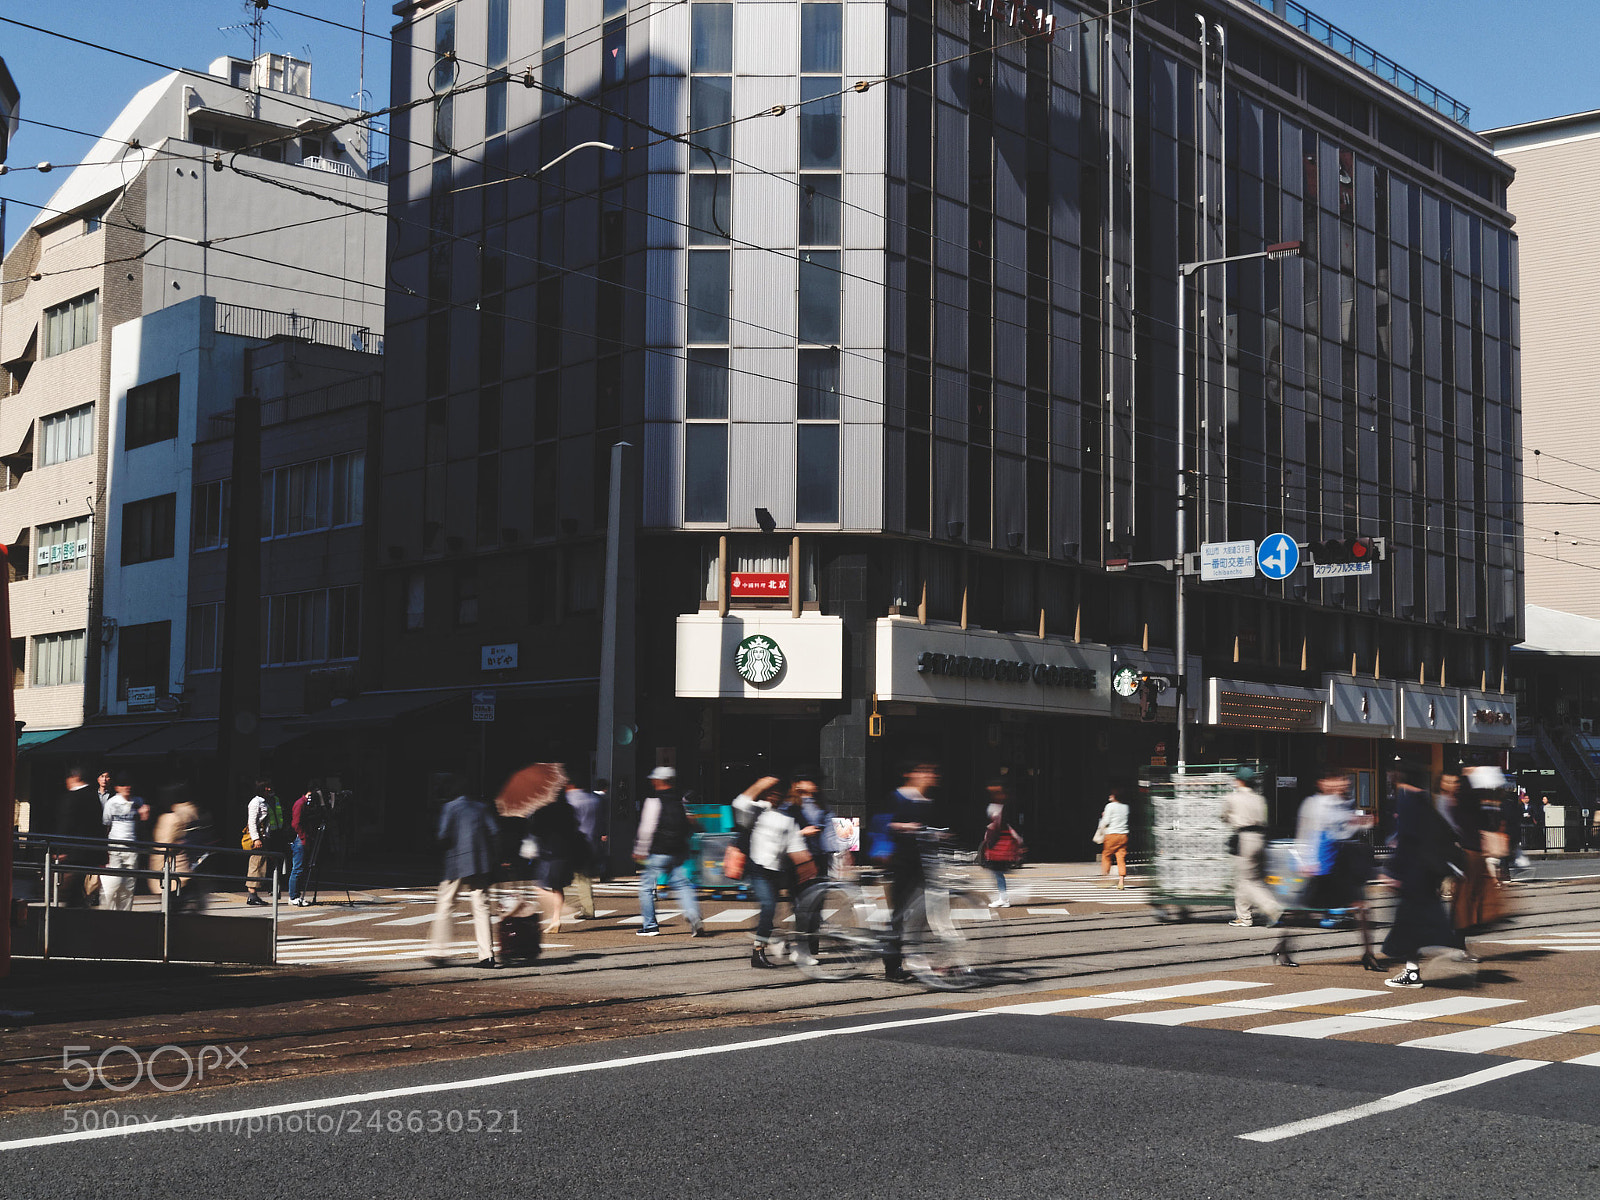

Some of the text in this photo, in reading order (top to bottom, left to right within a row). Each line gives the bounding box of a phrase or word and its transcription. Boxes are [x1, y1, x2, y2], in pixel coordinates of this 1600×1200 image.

[1203, 555, 1253, 569] 一番町交差点
[768, 579, 787, 589] 北京
[917, 651, 1097, 690] STARBUCKS COFFEE
